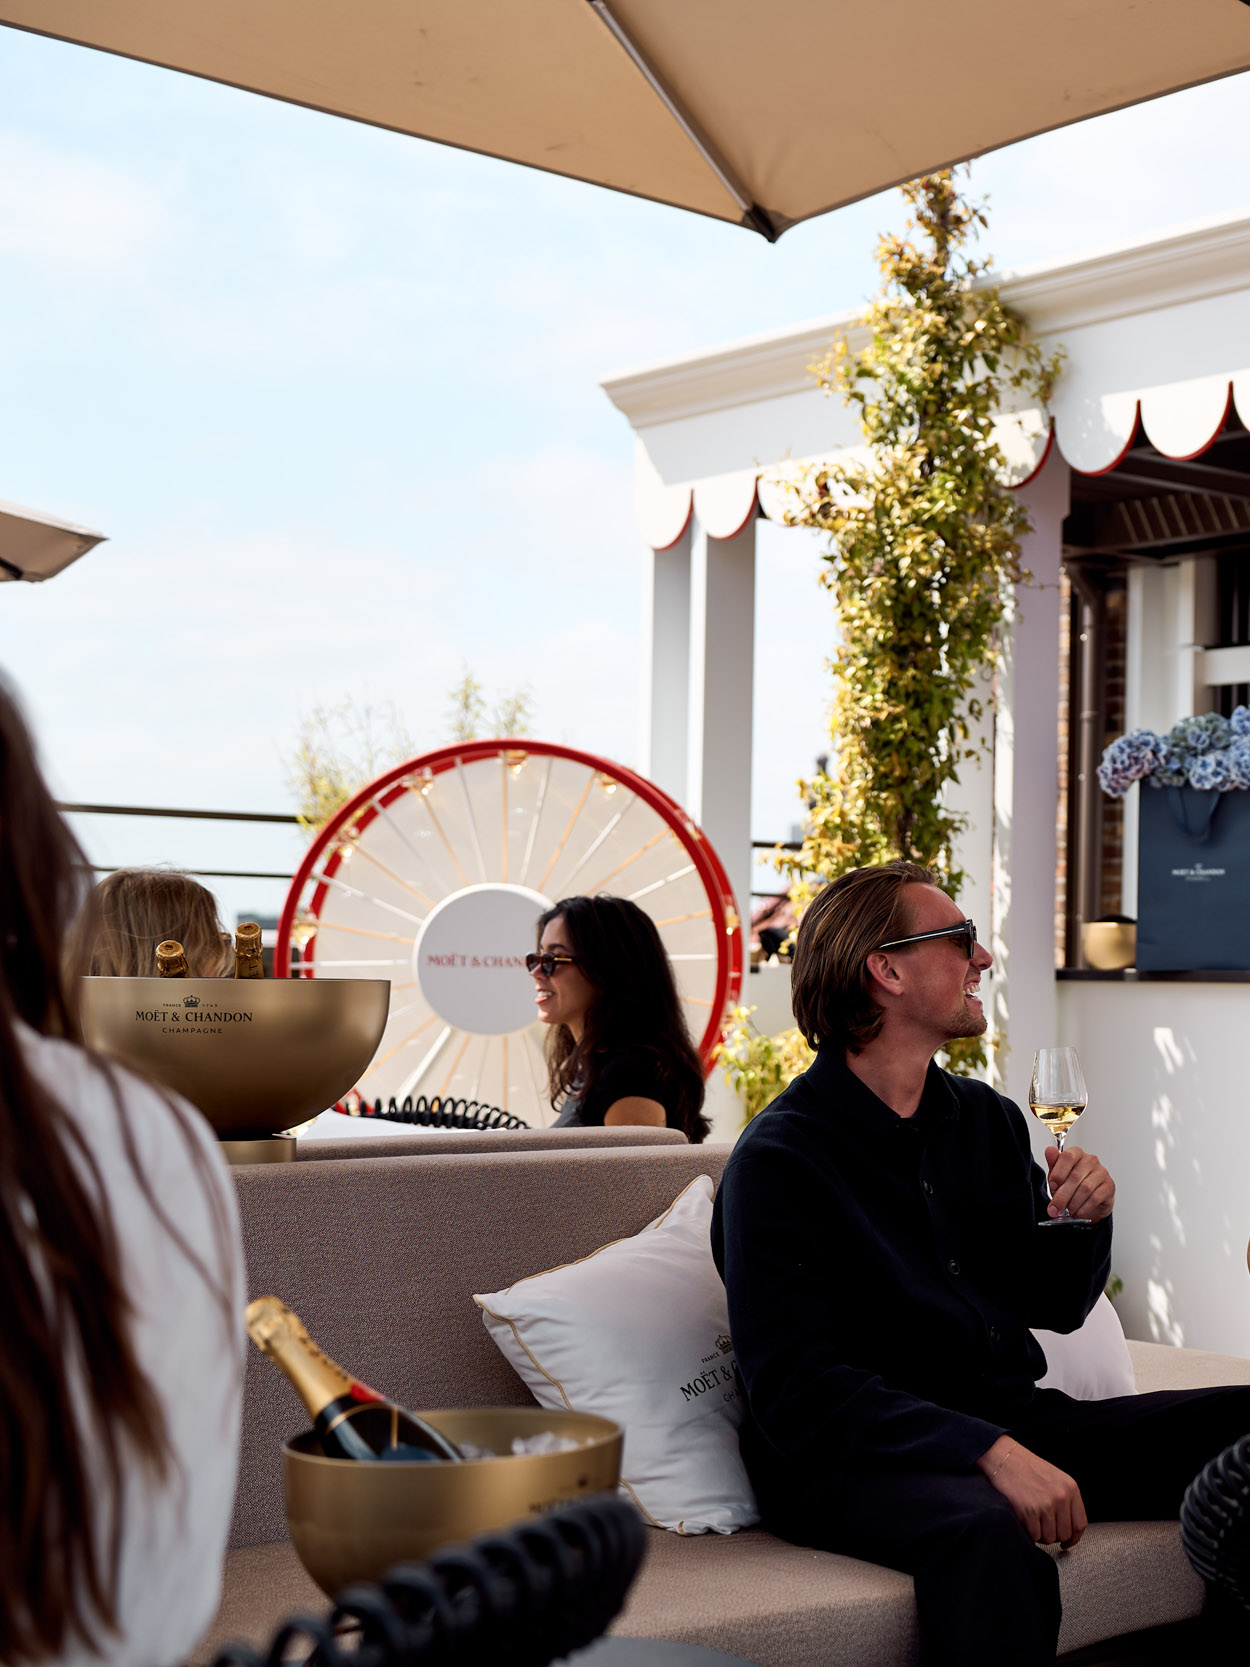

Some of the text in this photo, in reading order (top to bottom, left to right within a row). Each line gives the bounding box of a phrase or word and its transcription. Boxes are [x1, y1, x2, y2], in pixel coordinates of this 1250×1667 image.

[471, 956, 481, 968] &
[483, 955, 527, 968] CHAN
[135, 1009, 253, 1023] MOËT & CHANDON
[701, 1351, 720, 1363] FRANCE
[680, 1369, 721, 1402] MOËT
[720, 1365, 733, 1381] &
